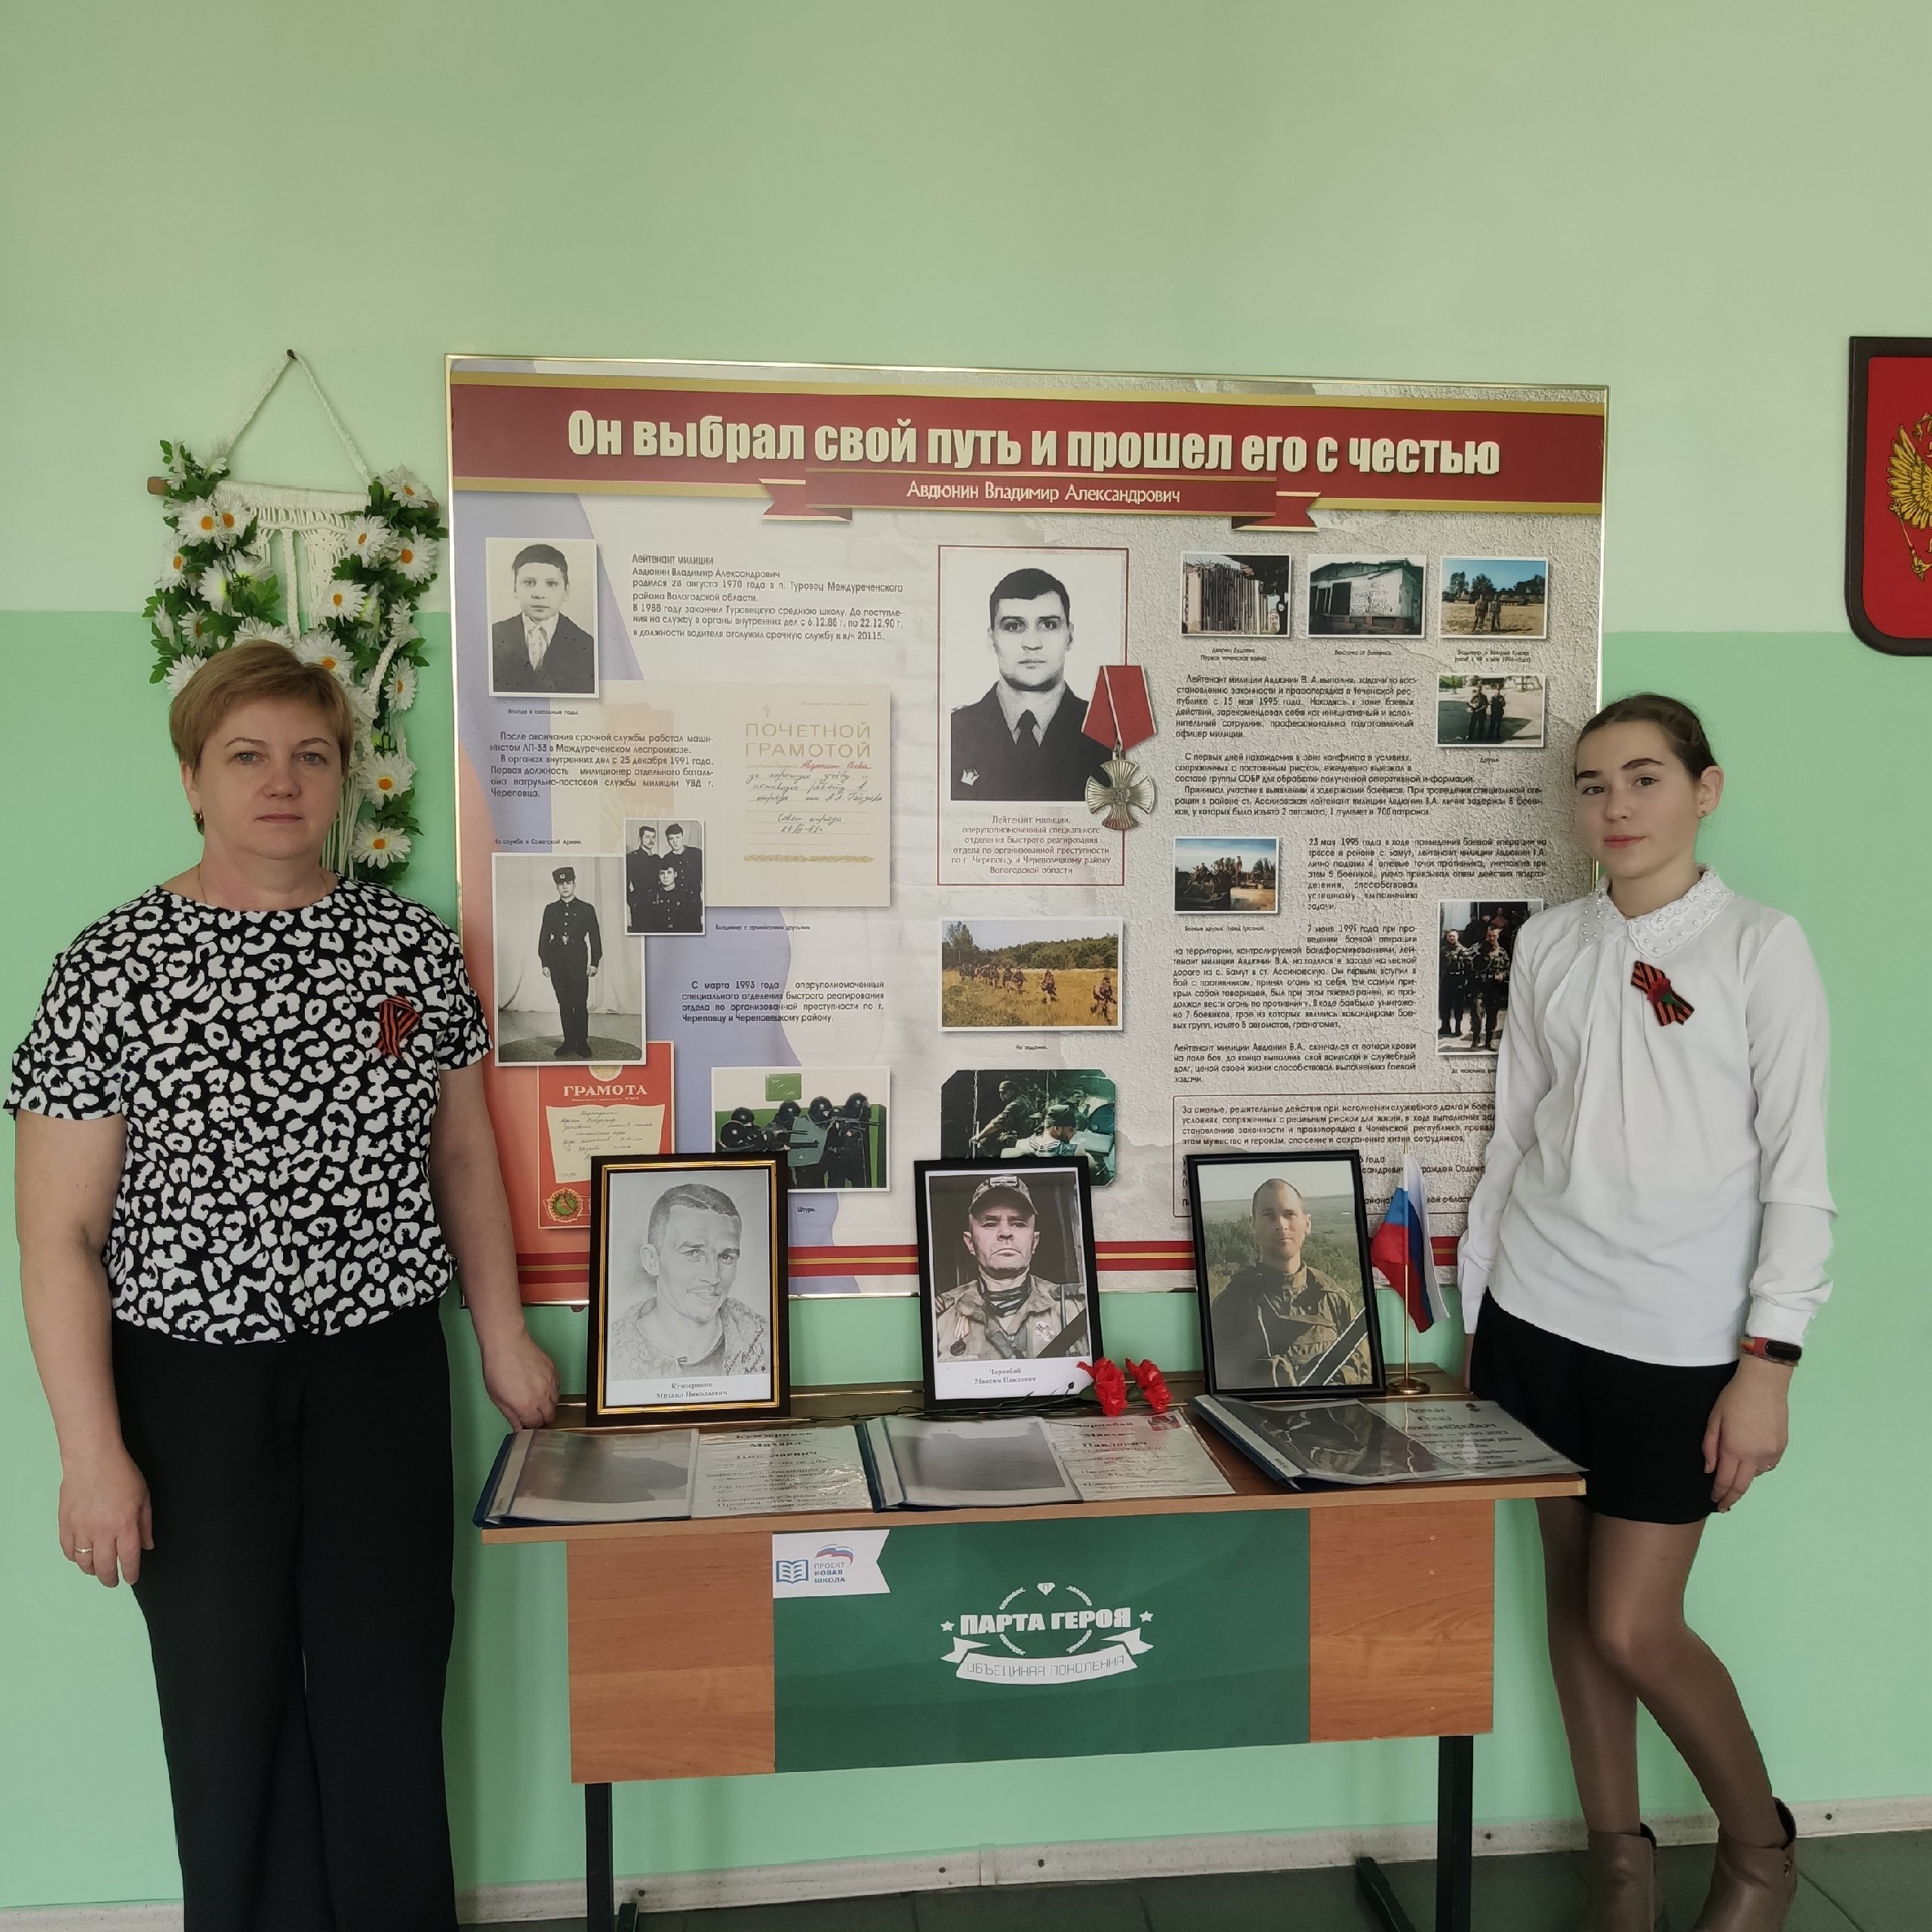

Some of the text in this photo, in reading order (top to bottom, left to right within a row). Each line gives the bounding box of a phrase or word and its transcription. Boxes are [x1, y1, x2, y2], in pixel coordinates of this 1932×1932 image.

[568, 410, 1501, 475] Он выбрал свой путь и прошел его с честью
[906, 481, 1180, 504] Авдюнин Владимир Александрович
[632, 567, 780, 580] Авдюнин Владимир Александрович
[632, 592, 665, 602] района
[667, 592, 720, 601] Вологодской
[745, 722, 870, 738] ПОЧЕТНОЙ
[746, 742, 870, 758] ГРАМОТОЙ
[501, 754, 506, 762] В
[508, 756, 543, 765] органах
[546, 757, 593, 766] внутренних
[620, 755, 630, 764] 25
[632, 756, 667, 767] декабря
[670, 756, 689, 765] 1991
[691, 981, 698, 989] С
[705, 983, 730, 991] марта
[736, 981, 755, 989] 1993
[795, 981, 884, 991] оперуполномоченный
[786, 991, 824, 1000] быстрого
[827, 993, 884, 1001] реагирования
[731, 1003, 798, 1013] организованной
[803, 1004, 859, 1013] преступности
[682, 1014, 727, 1024] Череповцу
[563, 1084, 648, 1096] ГРАМОТА
[961, 1607, 1131, 1635] ПАРТА ГЕРОЯ
